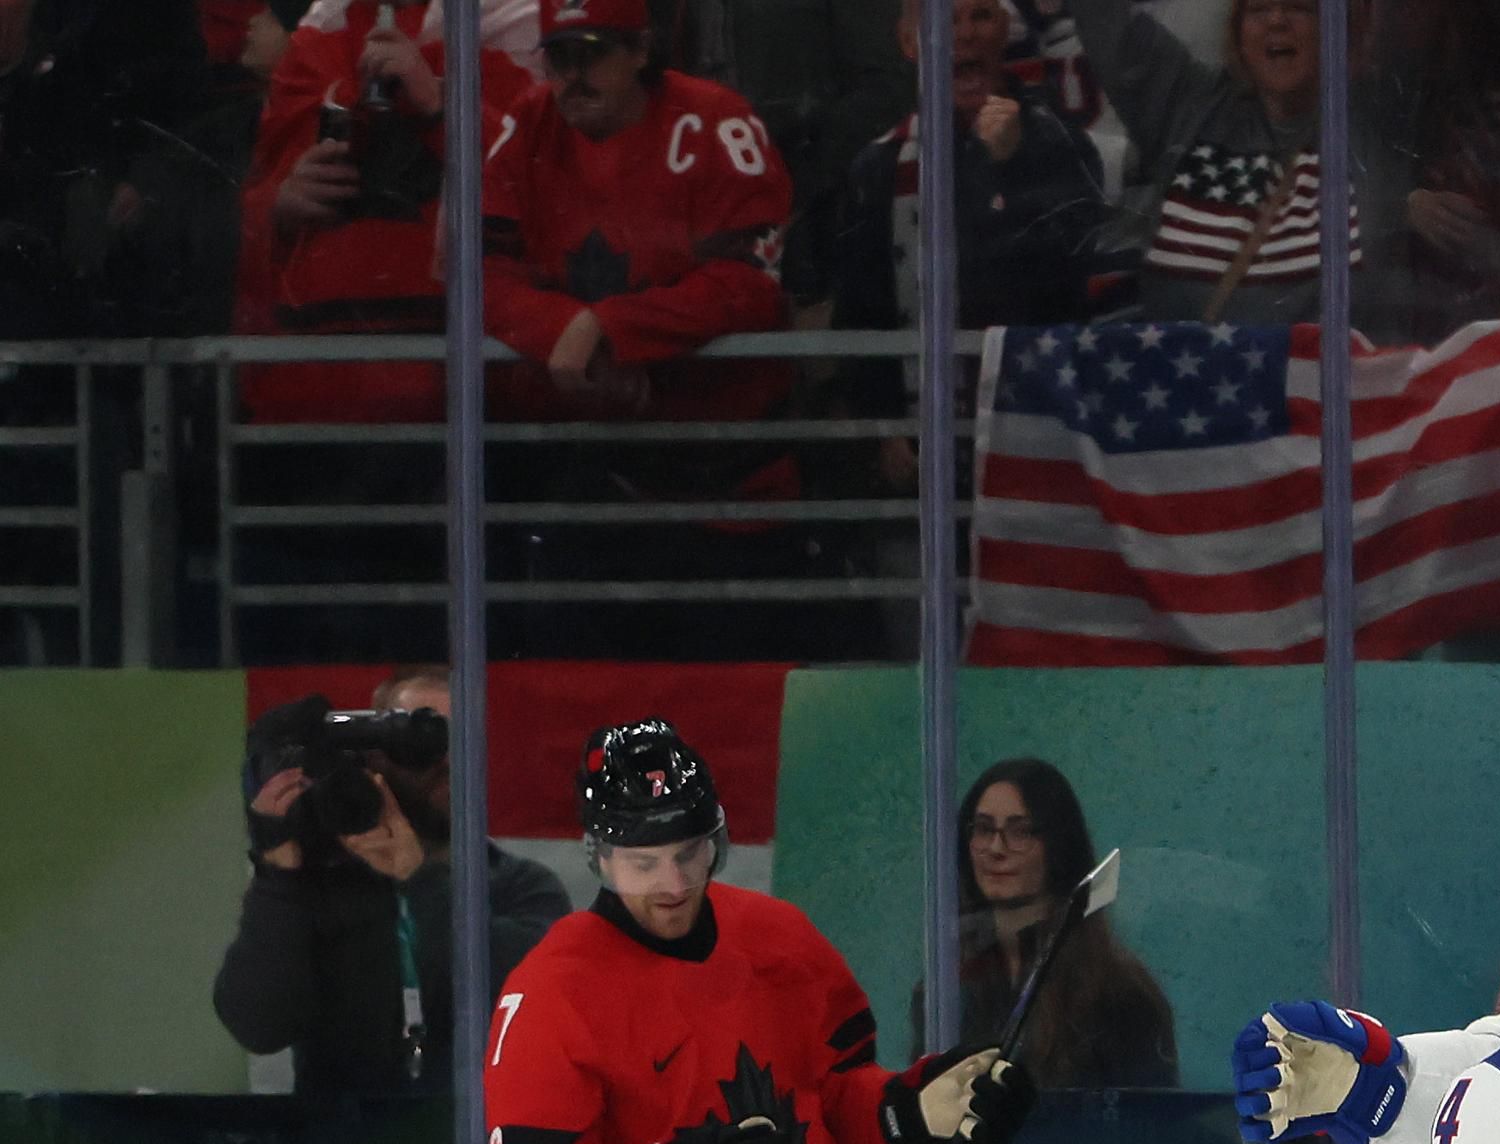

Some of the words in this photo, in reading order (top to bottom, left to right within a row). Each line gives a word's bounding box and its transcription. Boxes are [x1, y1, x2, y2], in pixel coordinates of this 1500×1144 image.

[667, 113, 702, 174] C
[646, 770, 666, 798] 7
[492, 993, 525, 1066] 7
